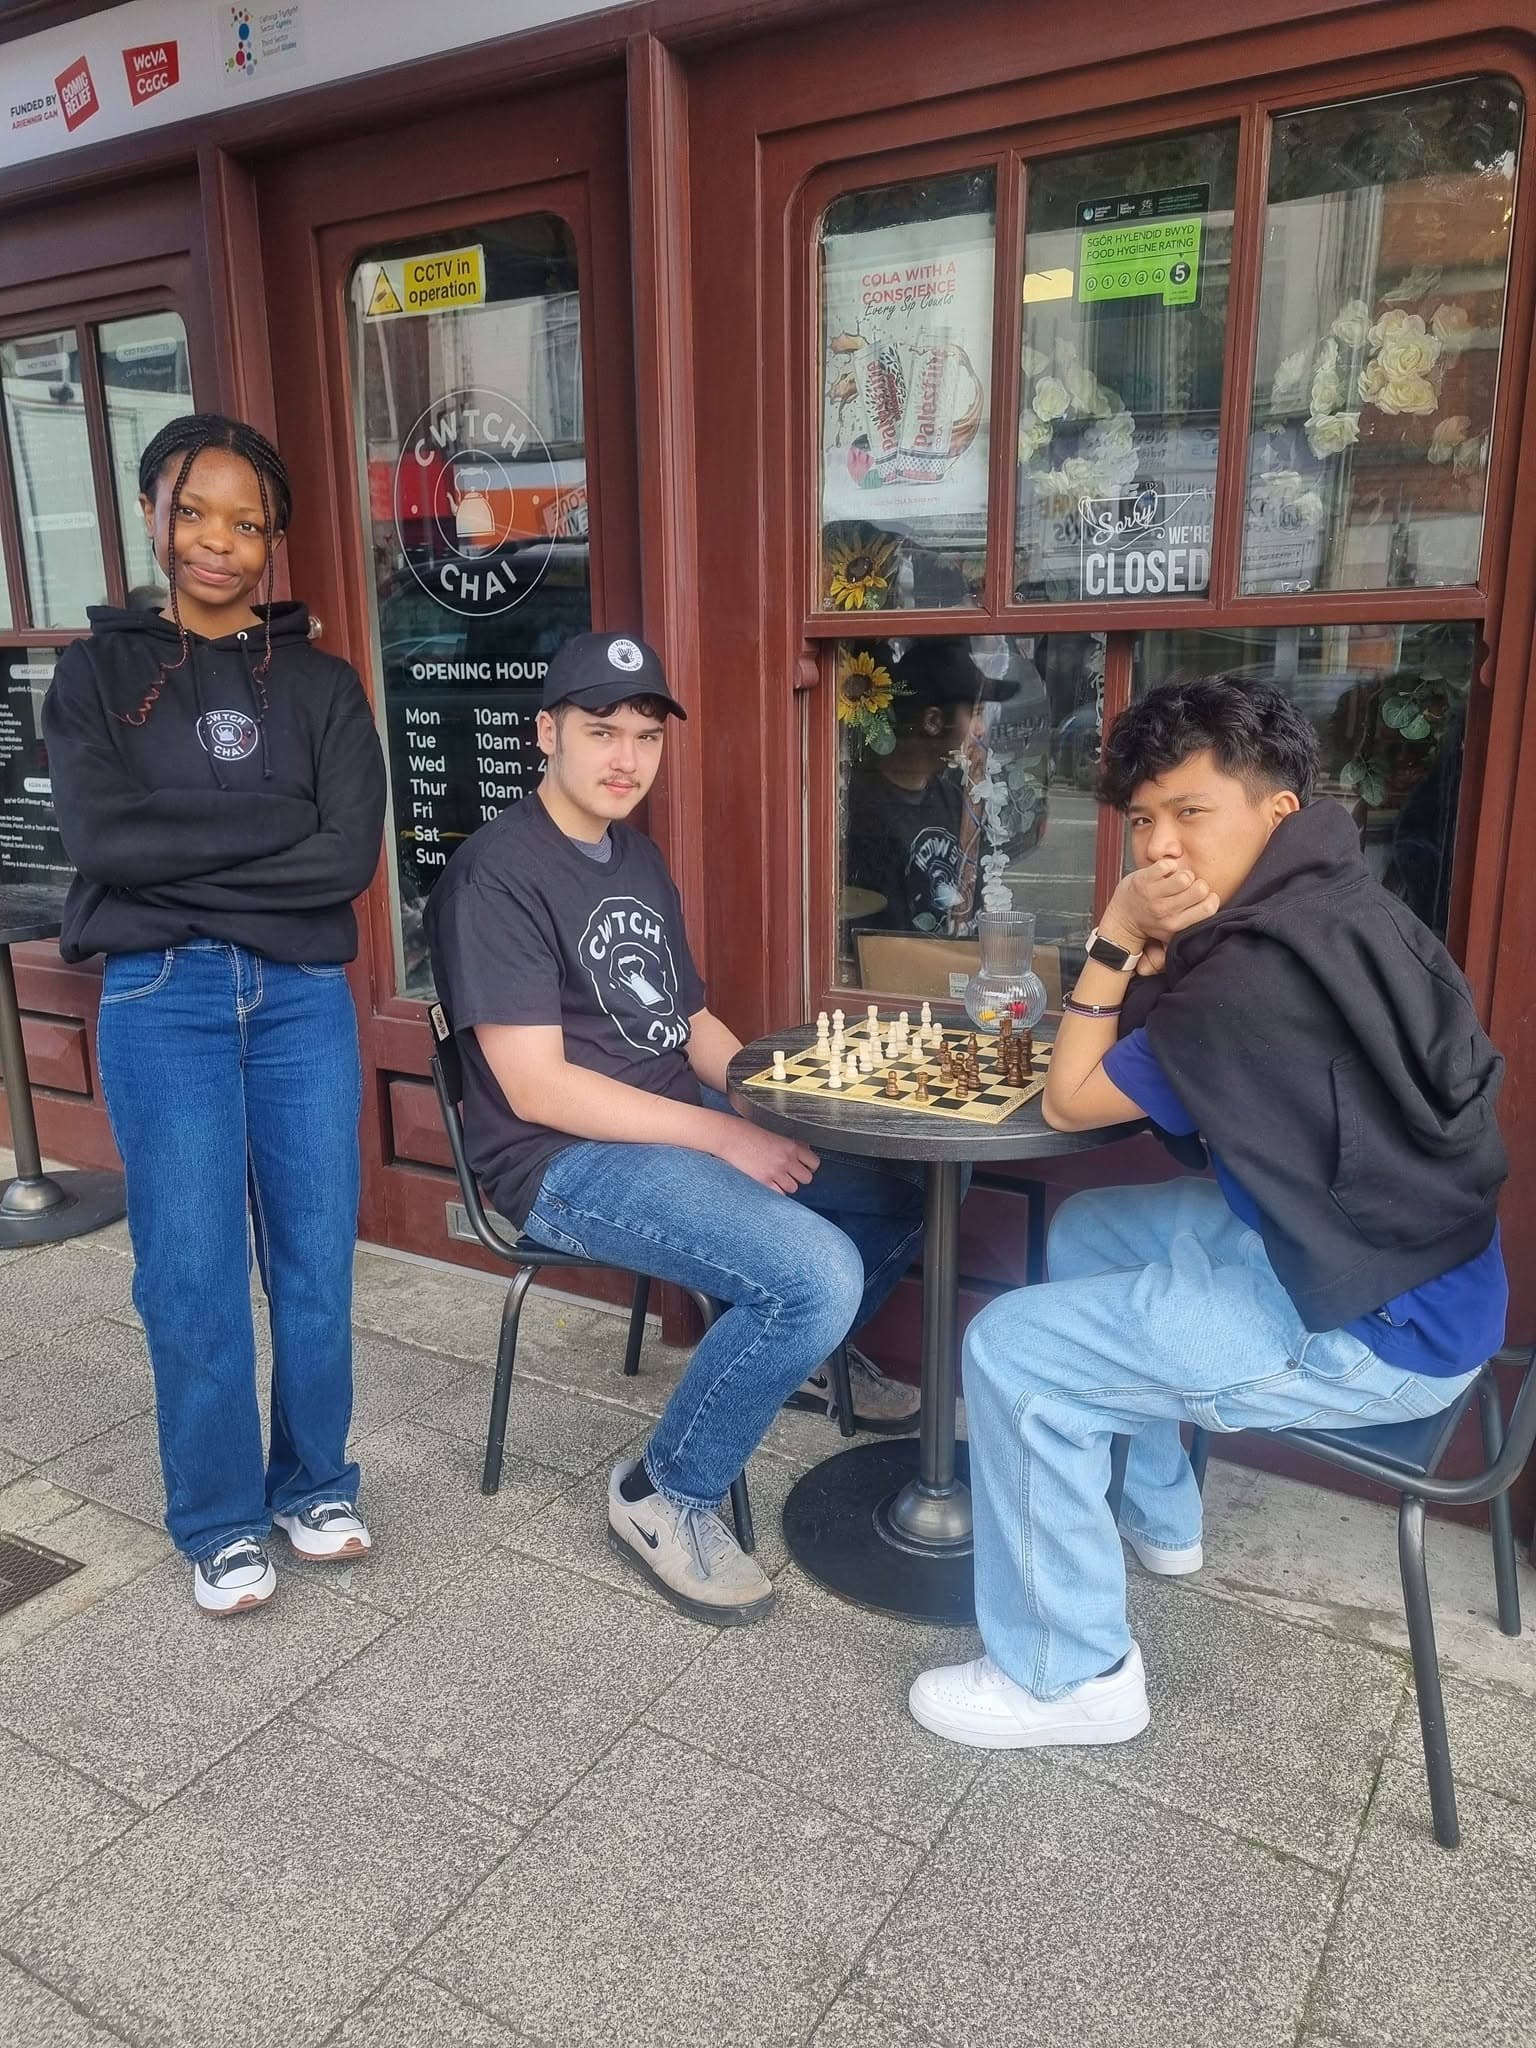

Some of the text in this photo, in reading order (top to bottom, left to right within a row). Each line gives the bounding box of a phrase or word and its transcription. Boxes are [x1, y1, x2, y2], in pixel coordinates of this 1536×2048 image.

[61, 71, 89, 103] COMIC
[10, 94, 57, 118] FUNDED BY
[65, 86, 92, 118] RELIEF
[1087, 224, 1194, 248] SGÔR HYLENDID BWYD
[1087, 238, 1194, 261] FOOD HYGIENE RATING
[414, 258, 470, 283] CCTV in
[862, 261, 956, 287] COLA WITH A
[1174, 264, 1186, 282] 5
[409, 280, 477, 307] operation
[862, 279, 956, 305] CONSCIENCE
[864, 299, 897, 320] Every
[901, 294, 916, 319] Sip
[414, 409, 527, 468] CWTCH
[1093, 504, 1157, 546] Sorry
[1168, 525, 1210, 545] WE'RE
[440, 560, 518, 601] CHAI
[1085, 548, 1210, 595] CLOSED
[412, 661, 549, 680] OPENING HOUR
[405, 708, 441, 725] Mon
[474, 708, 519, 726] 10am
[214, 745, 244, 757] CHAI
[406, 731, 436, 749] Tue
[475, 732, 521, 750] 10am
[408, 755, 446, 773] Wed
[477, 757, 522, 775] 10am
[409, 778, 447, 796] Thur
[478, 781, 524, 799] 10am
[412, 801, 433, 819] Fri
[414, 825, 440, 842] Sat
[415, 848, 446, 866] Sun
[589, 911, 661, 961] CWTCH
